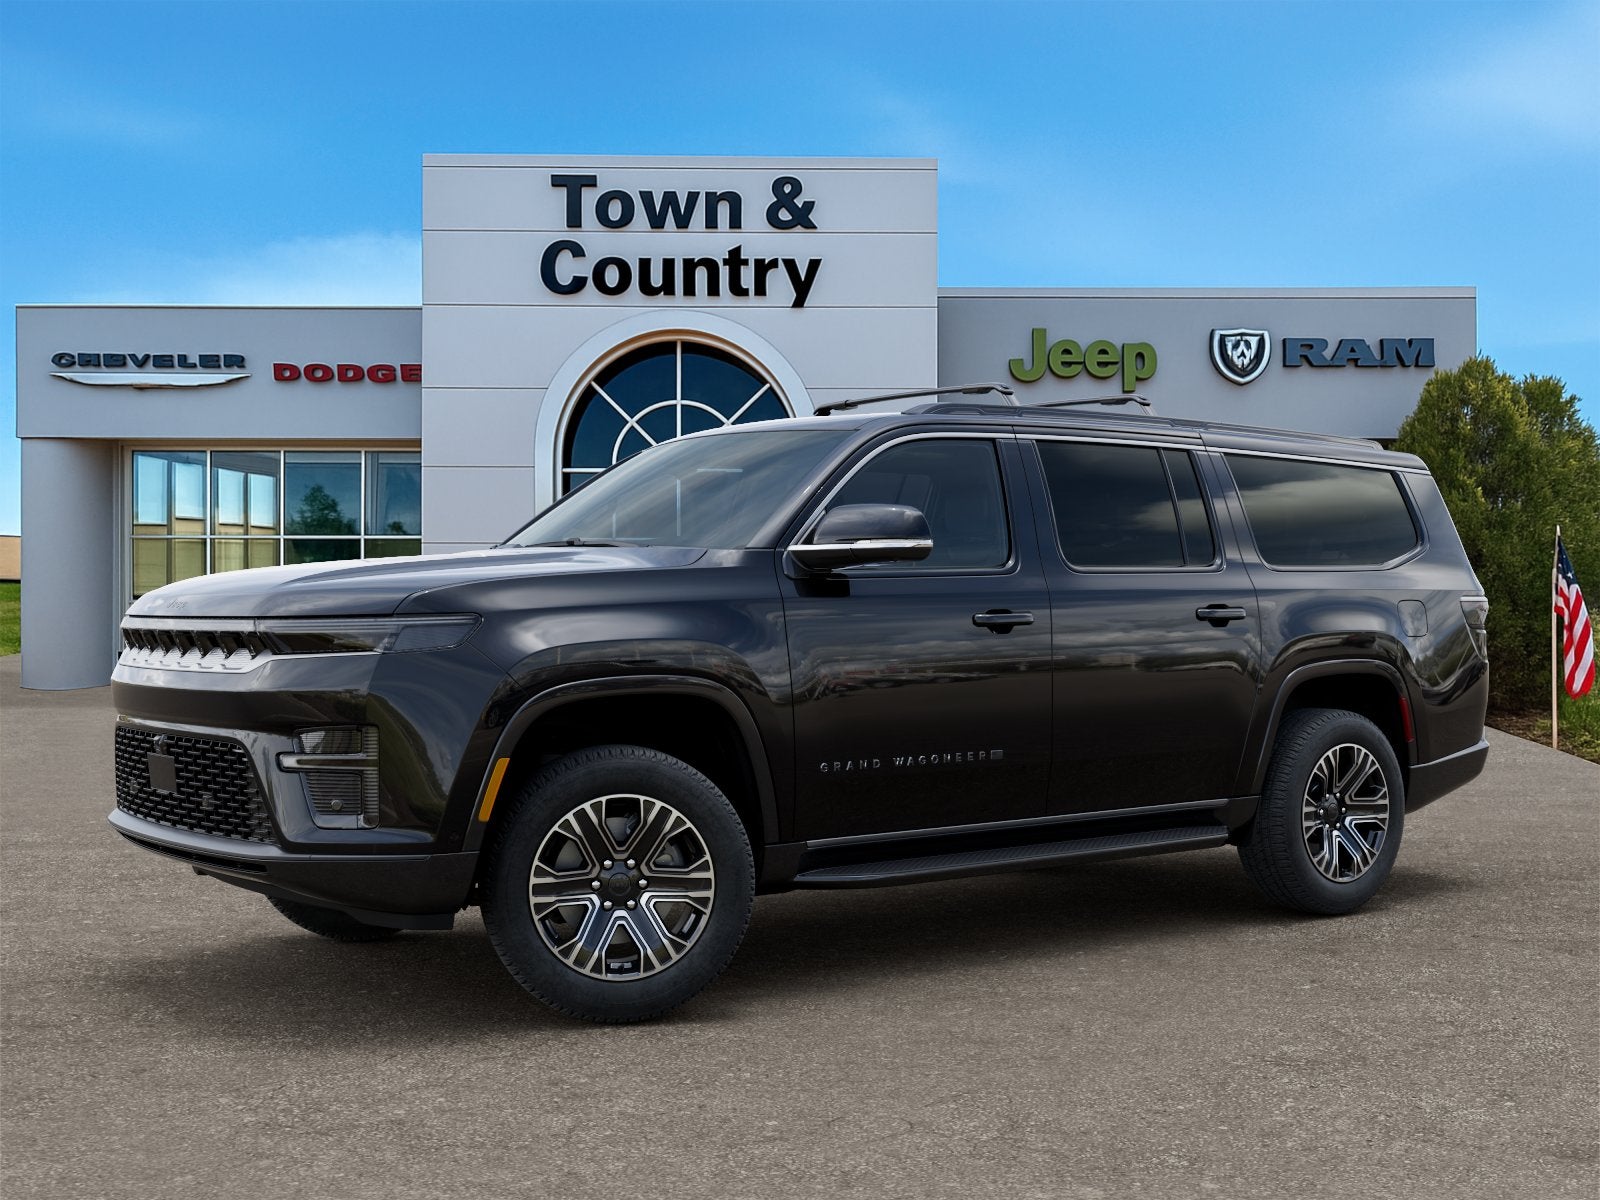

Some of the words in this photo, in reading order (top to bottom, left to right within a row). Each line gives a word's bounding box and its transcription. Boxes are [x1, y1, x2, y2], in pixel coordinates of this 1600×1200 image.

[550, 174, 742, 229] Town
[766, 175, 818, 230] &
[540, 239, 822, 308] Country
[273, 362, 421, 383] DODGE
[1009, 328, 1157, 392] Jeep
[1282, 337, 1436, 368] RAM
[820, 758, 881, 772] GRAND
[893, 751, 986, 767] WAGONEER
